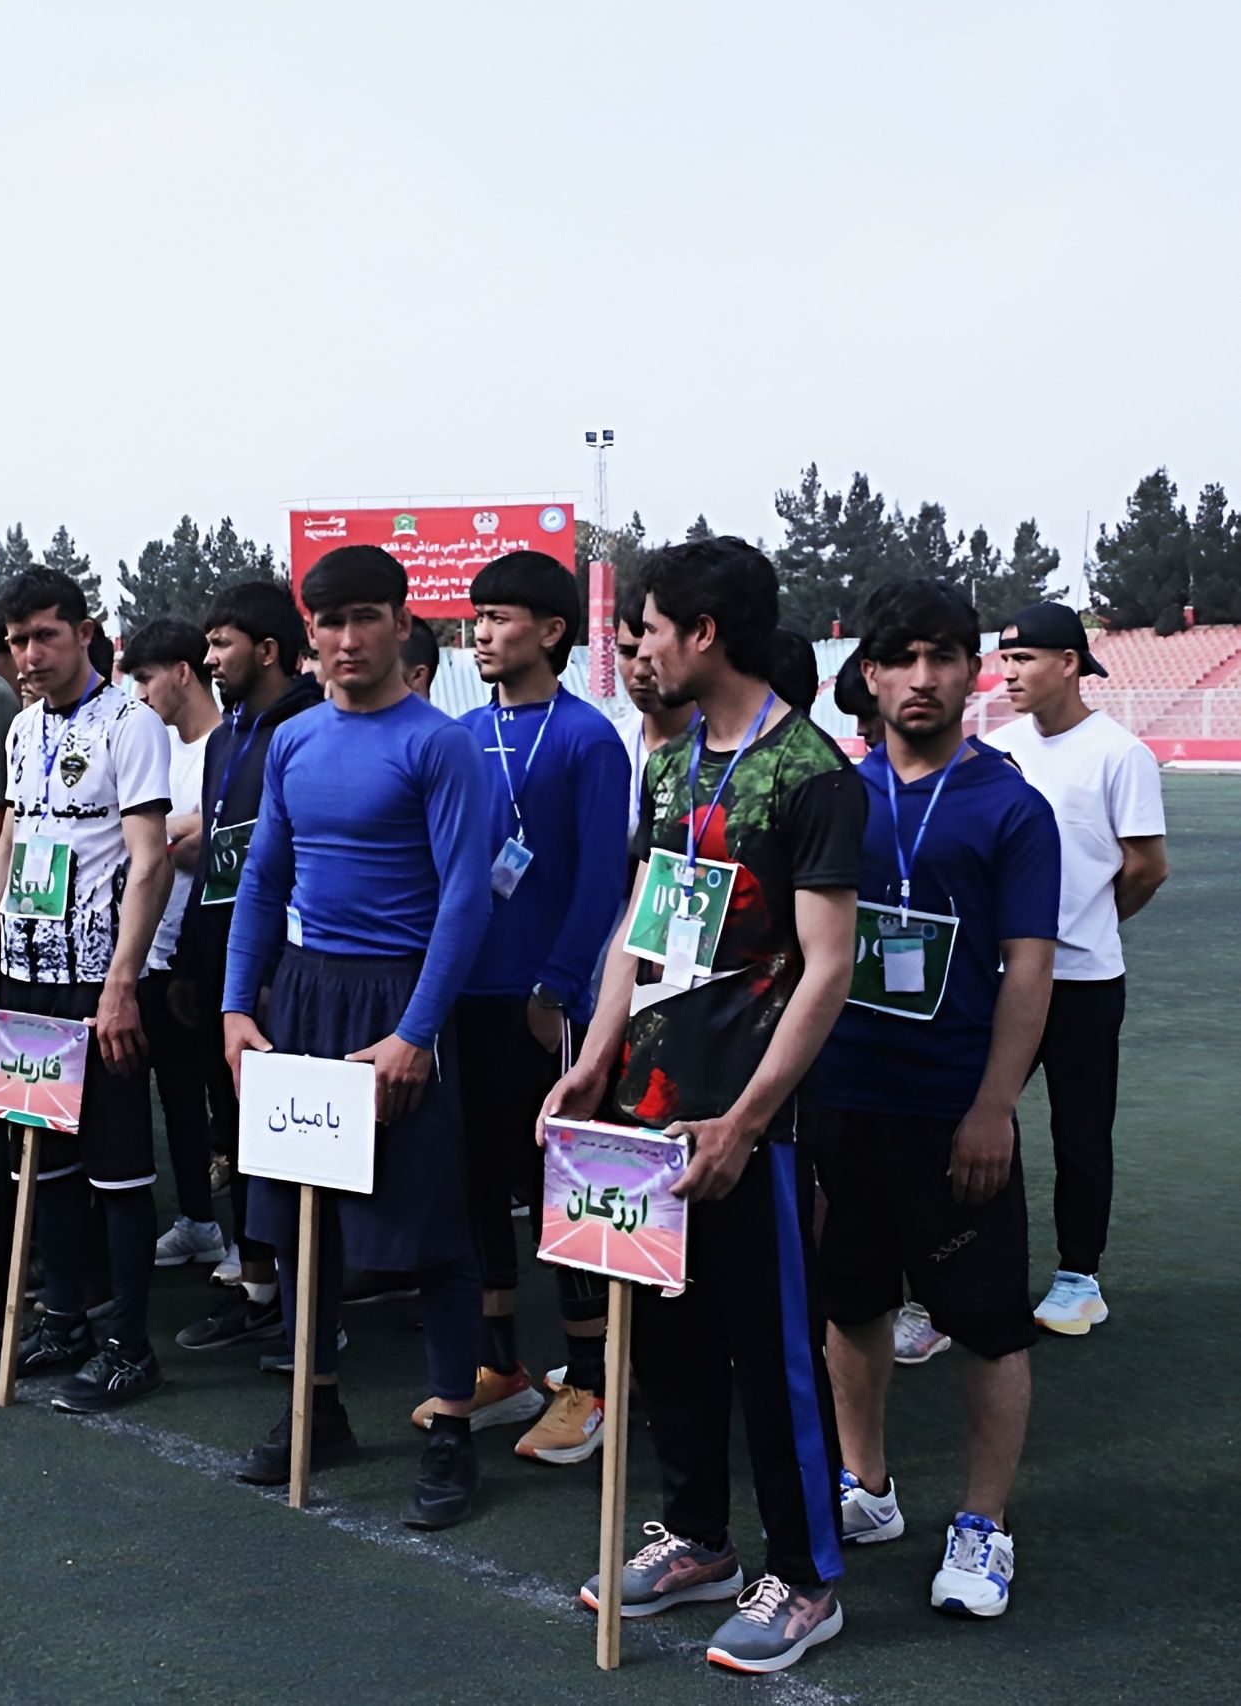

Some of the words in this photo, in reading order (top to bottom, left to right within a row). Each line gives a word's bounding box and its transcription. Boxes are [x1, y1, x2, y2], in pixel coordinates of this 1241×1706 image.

[51, 798, 109, 824] منتخب
[0, 1052, 62, 1084] فاریاب
[268, 1097, 340, 1139] بامیان
[566, 1183, 648, 1234] ارزگان
